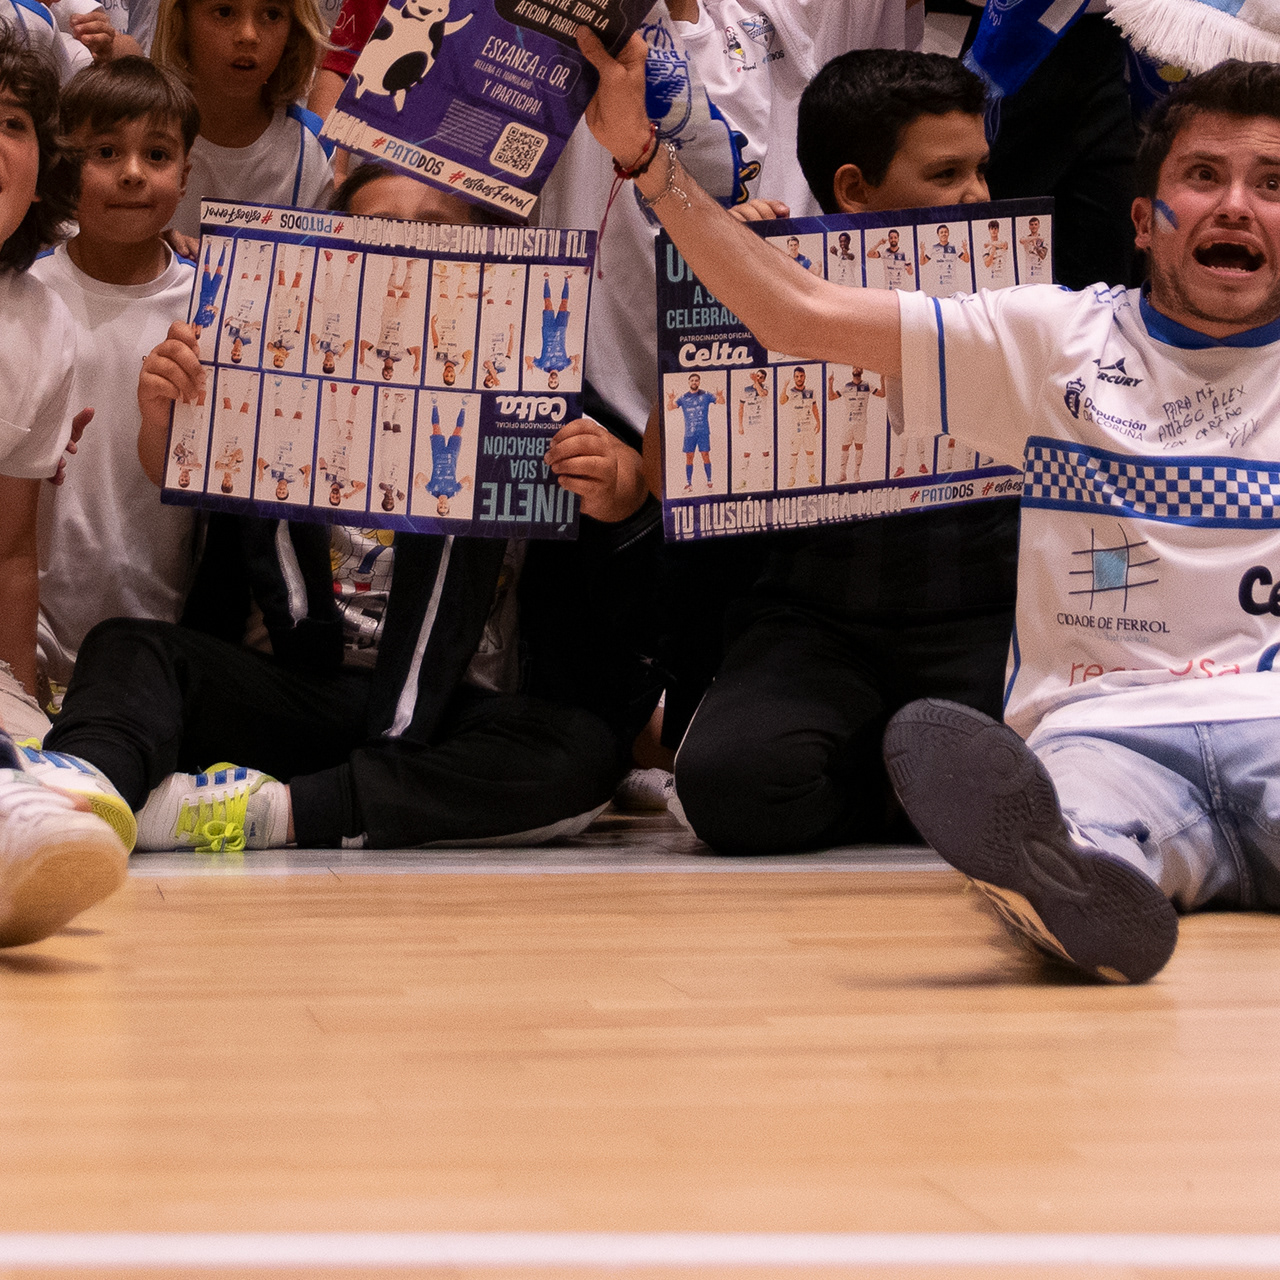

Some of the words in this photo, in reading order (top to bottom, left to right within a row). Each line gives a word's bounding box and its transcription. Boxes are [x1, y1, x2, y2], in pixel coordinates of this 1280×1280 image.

[514, 0, 549, 26] AFICIÓN
[572, 0, 596, 25] TODA
[596, 11, 610, 31] LA
[481, 35, 540, 76] ESCANEA
[536, 65, 548, 80] EL
[481, 79, 492, 95] Y
[372, 136, 446, 177] #PATODOS
[202, 205, 273, 226] #estoesFerrol
[280, 212, 344, 235] #PATODOS
[494, 225, 561, 261] ILUSIÓN
[565, 230, 588, 259] TU
[679, 333, 728, 342] PATROCINADOR
[728, 331, 752, 340] OFICIAL
[678, 341, 754, 368] Celta
[1096, 371, 1144, 389] ERCURY
[495, 395, 568, 422] Celta
[1162, 395, 1193, 419] PARA
[1212, 384, 1248, 415] ALEX
[495, 420, 519, 430] OFICIAL
[1084, 396, 1148, 432] Deputación
[1095, 414, 1145, 442] CORUÑA
[479, 482, 576, 532] ÚNETE
[671, 506, 695, 540] TU
[700, 496, 768, 537] ILUSIÓN
[909, 483, 974, 503] #PATODOS
[1097, 616, 1113, 631] DE
[1116, 616, 1170, 634] FERROL
